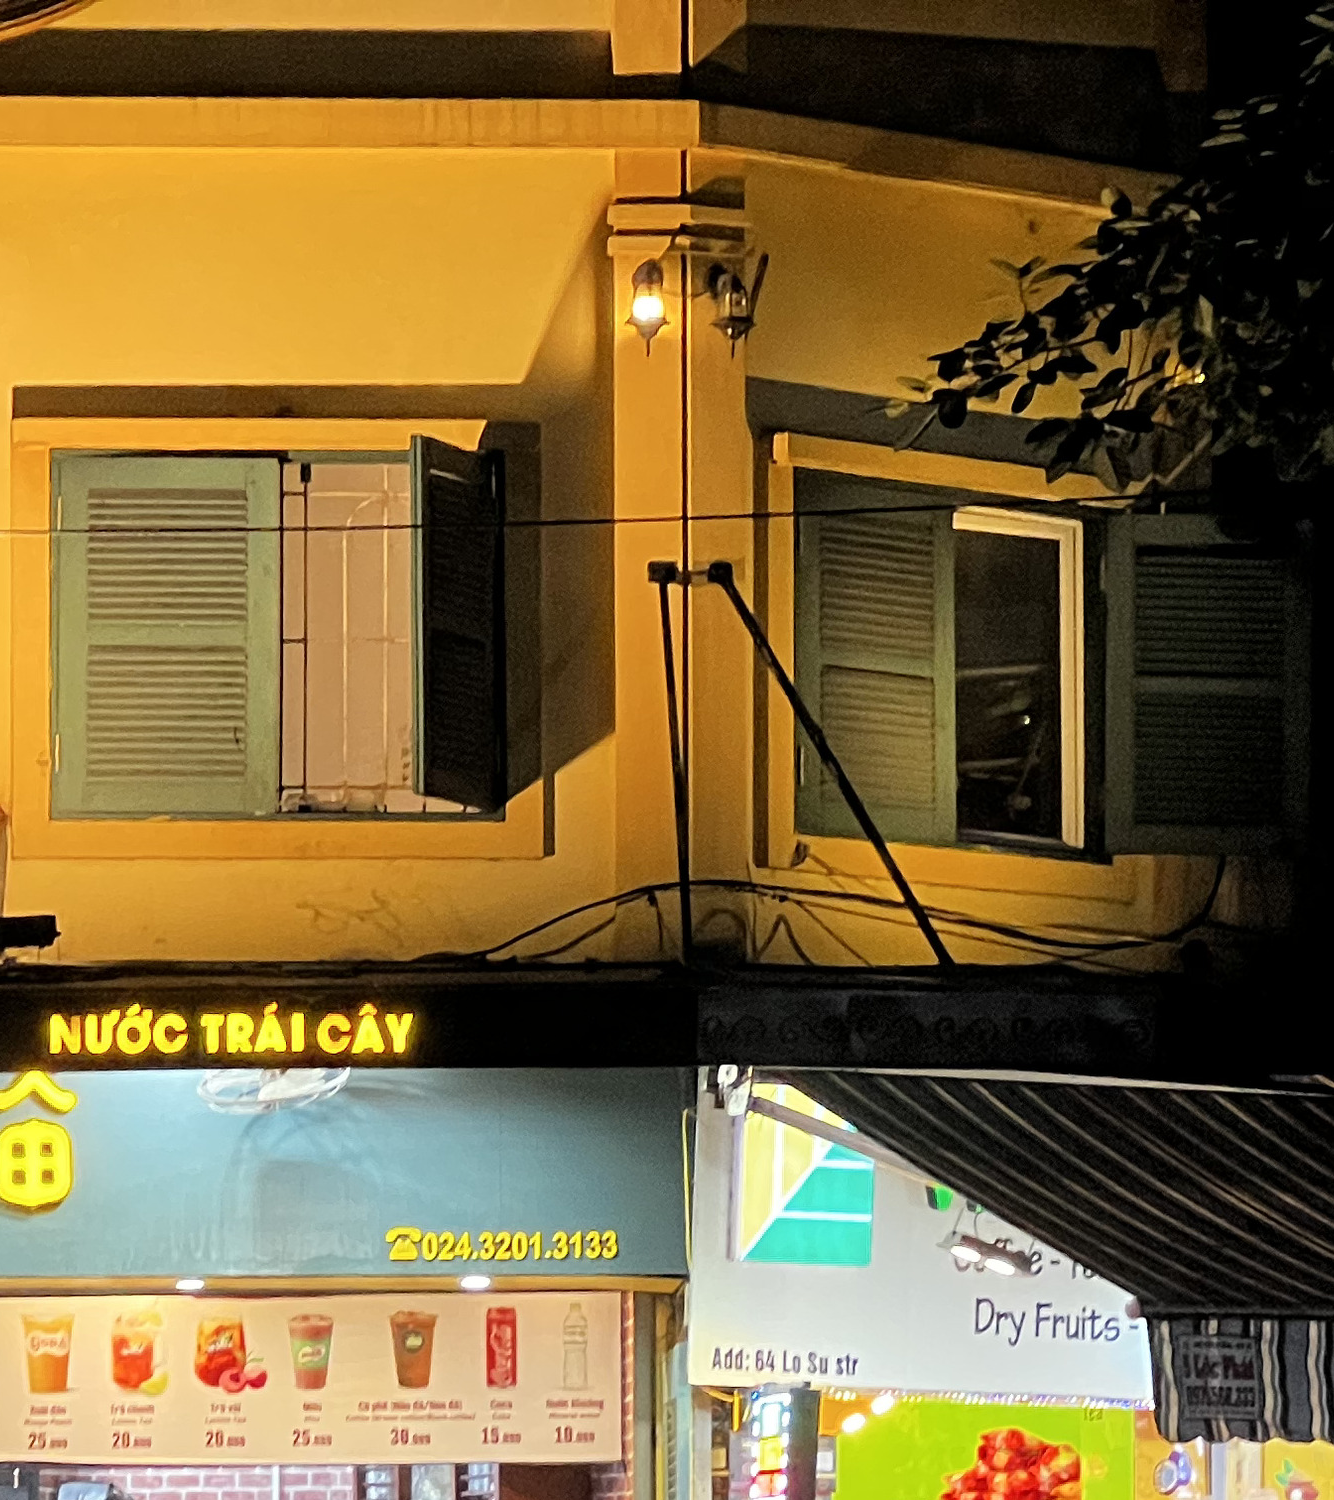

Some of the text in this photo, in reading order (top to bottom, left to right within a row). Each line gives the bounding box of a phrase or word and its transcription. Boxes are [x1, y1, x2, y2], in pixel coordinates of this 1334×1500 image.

[49, 1001, 414, 1054] NƯỚC TRÁI CÂY
[421, 1230, 617, 1261] 024.3201.3133
[974, 1298, 1025, 1347] Dry
[1035, 1302, 1121, 1342] Fruits
[712, 1348, 858, 1375] Add: 64 Lo Su str
